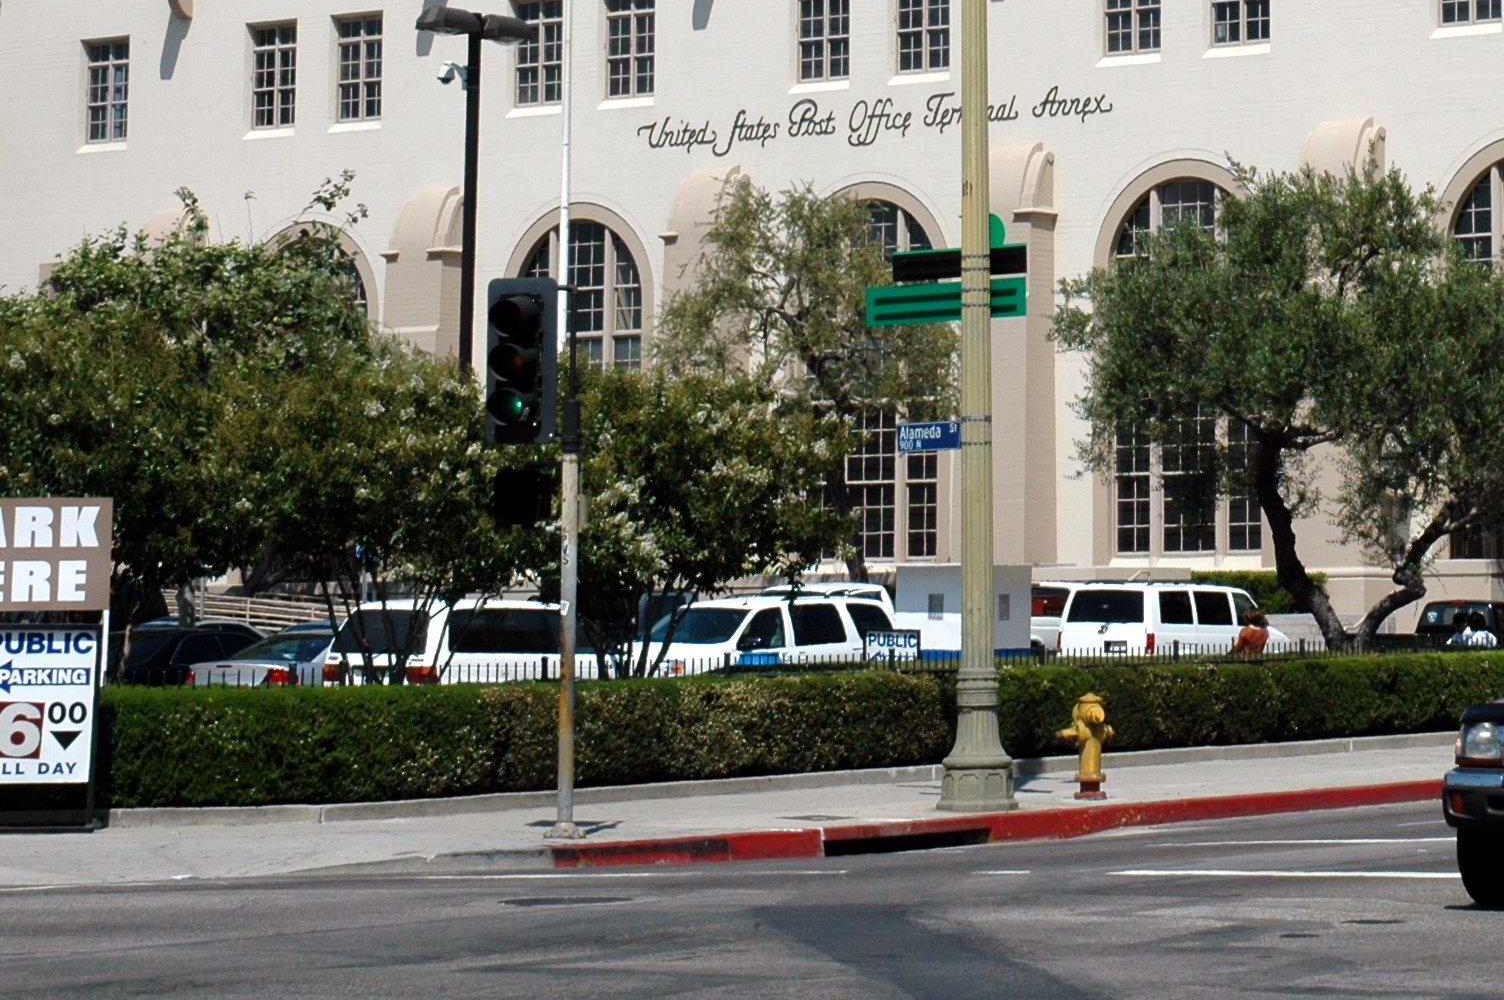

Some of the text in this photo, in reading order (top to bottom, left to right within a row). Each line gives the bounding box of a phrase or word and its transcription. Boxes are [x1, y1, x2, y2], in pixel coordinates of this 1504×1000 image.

[637, 85, 1113, 157] United States Post Office Ternal Annex
[900, 422, 958, 440] Alameda St
[0, 506, 101, 548] RK
[0, 560, 88, 602] RE
[0, 632, 94, 655] UBLIC
[868, 633, 918, 648] PUBLIC
[0, 668, 89, 686] PARKING
[0, 763, 78, 776] LL DAY
